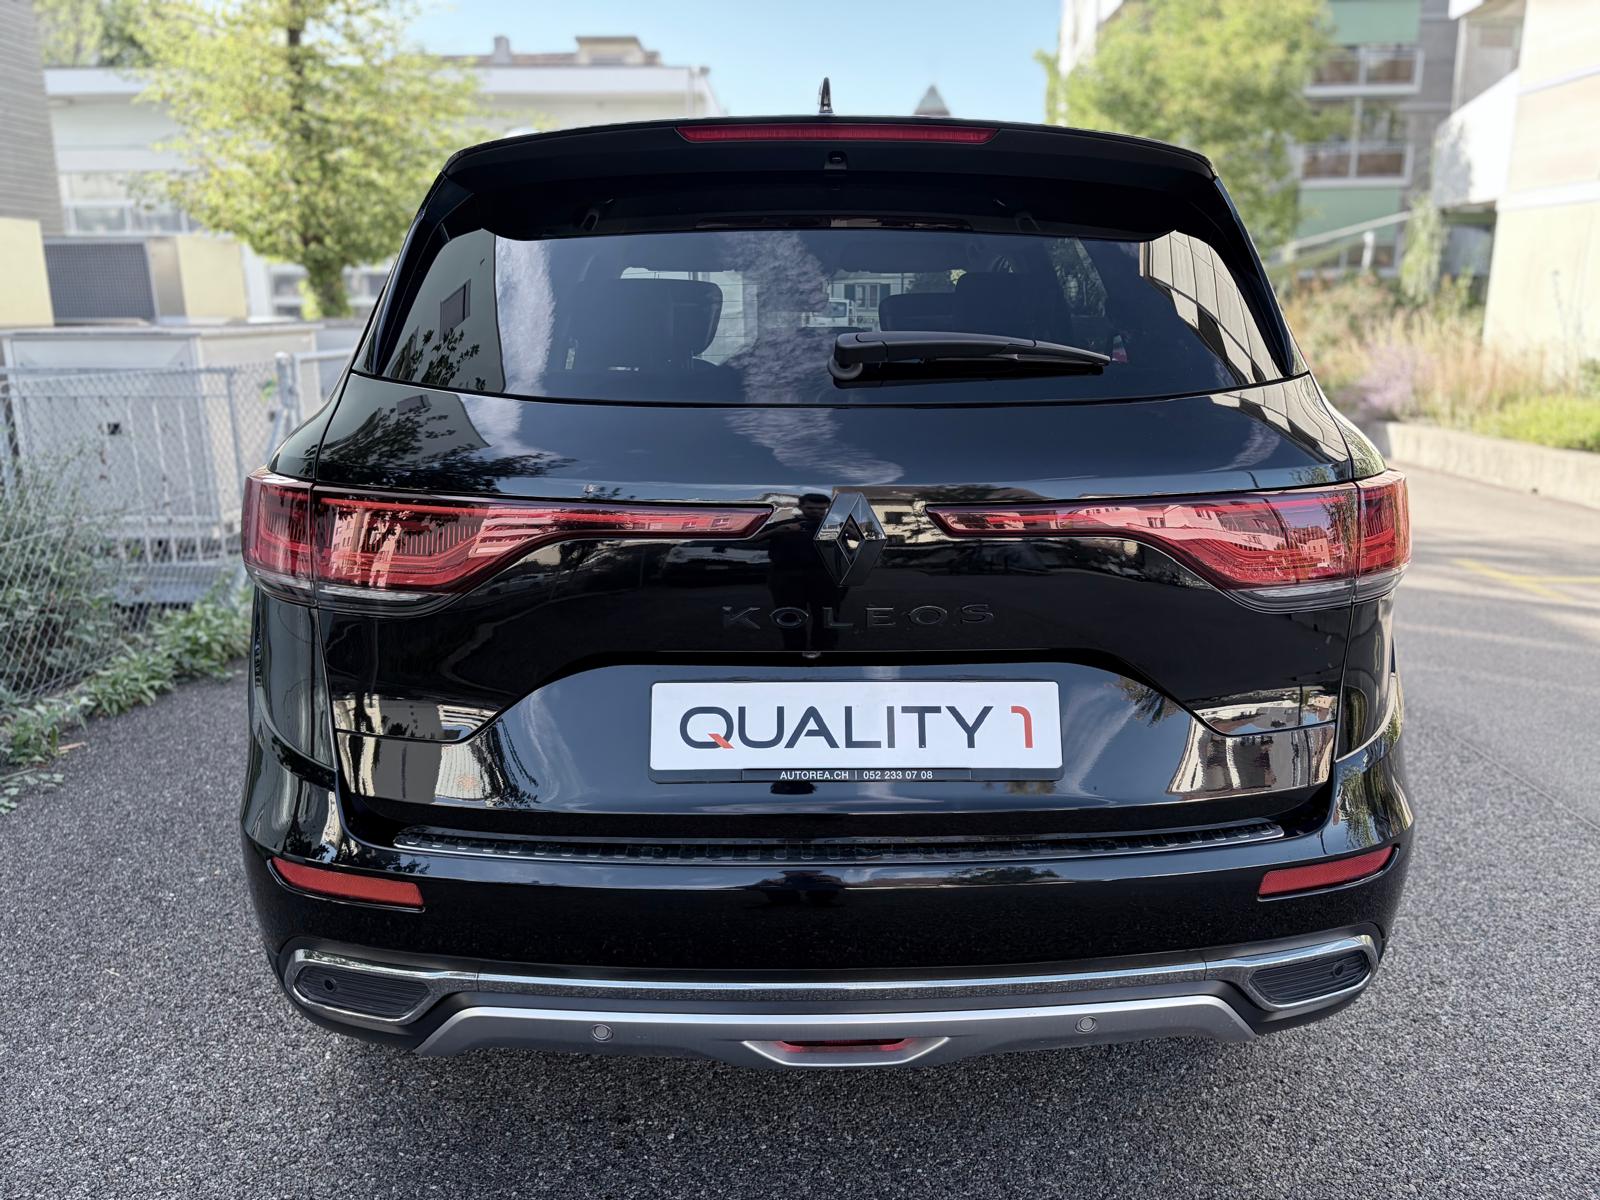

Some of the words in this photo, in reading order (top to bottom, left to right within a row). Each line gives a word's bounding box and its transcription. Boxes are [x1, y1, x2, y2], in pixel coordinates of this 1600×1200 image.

[721, 603, 994, 630] KOLEOS
[679, 705, 994, 749] QUALITY
[1010, 705, 1034, 749] 1
[780, 770, 849, 780] AUTOREA.CH
[863, 770, 881, 780] 052
[884, 770, 902, 780] 233
[905, 770, 917, 780] 07
[920, 770, 933, 780] 08
